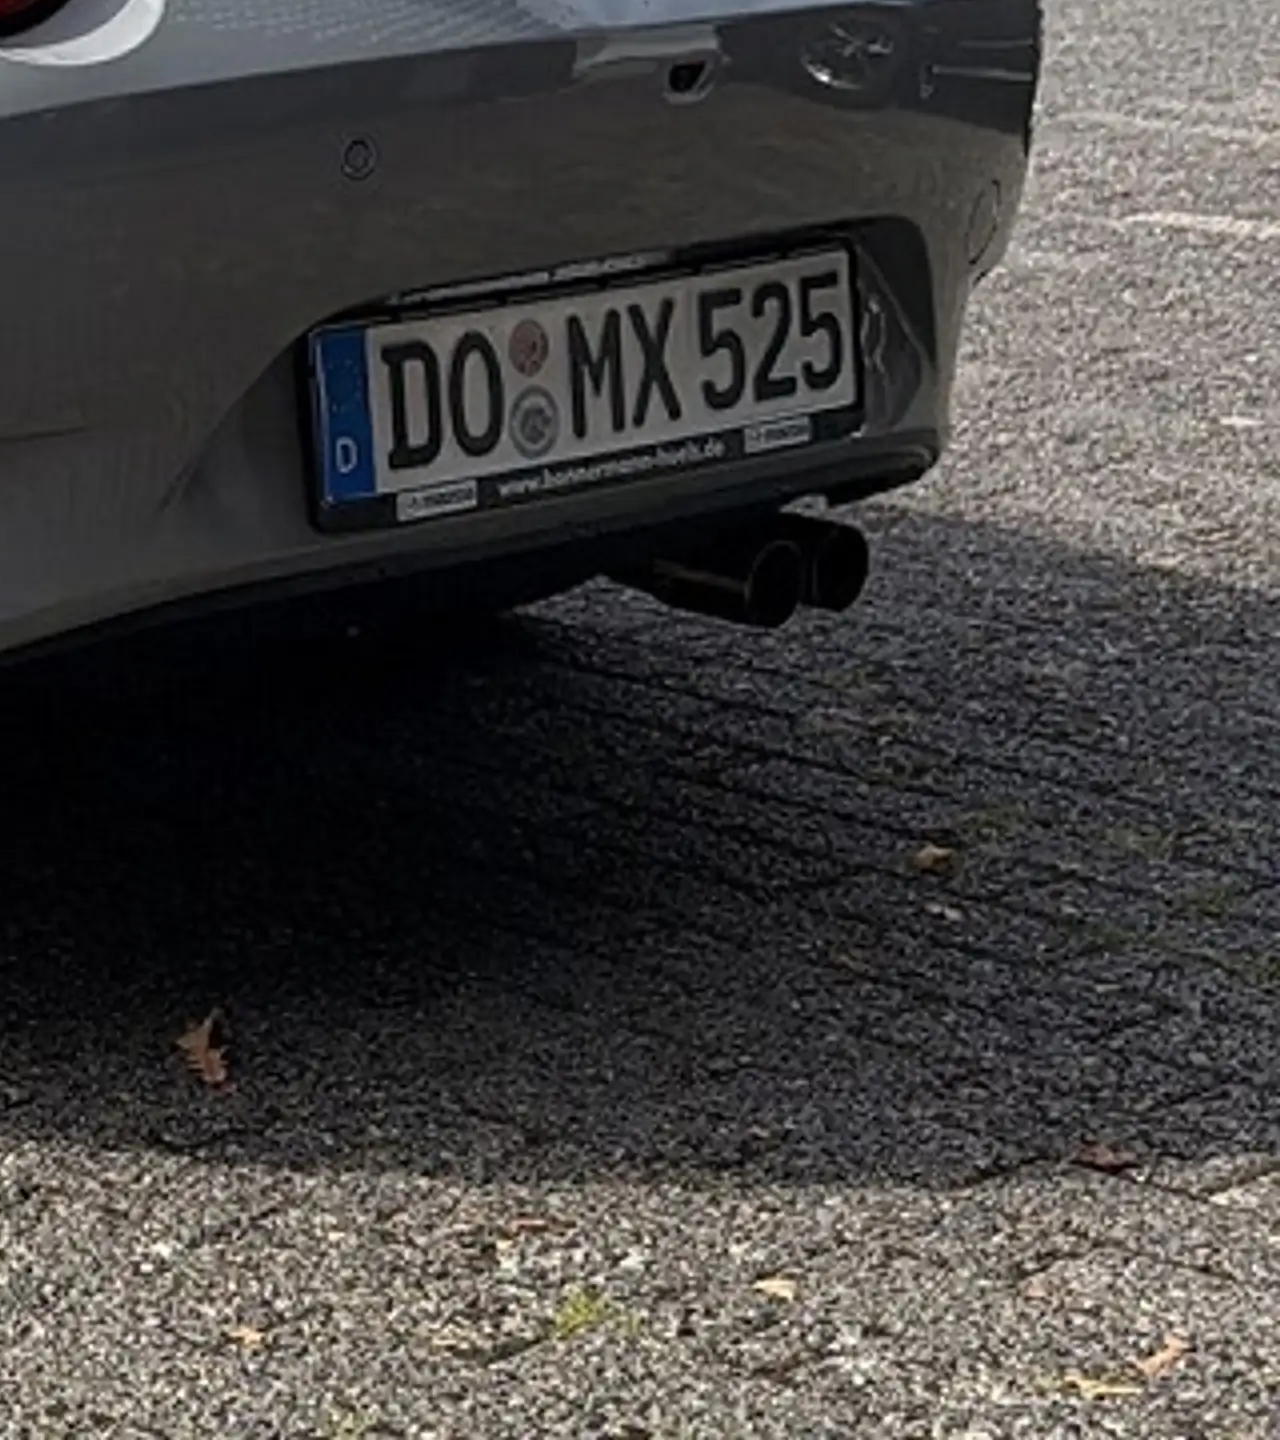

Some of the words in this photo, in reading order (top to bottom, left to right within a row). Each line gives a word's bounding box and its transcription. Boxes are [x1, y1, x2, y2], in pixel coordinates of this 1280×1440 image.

[380, 330, 505, 470] DO
[565, 296, 683, 440] MX
[696, 270, 844, 411] 525
[334, 436, 358, 475] D
